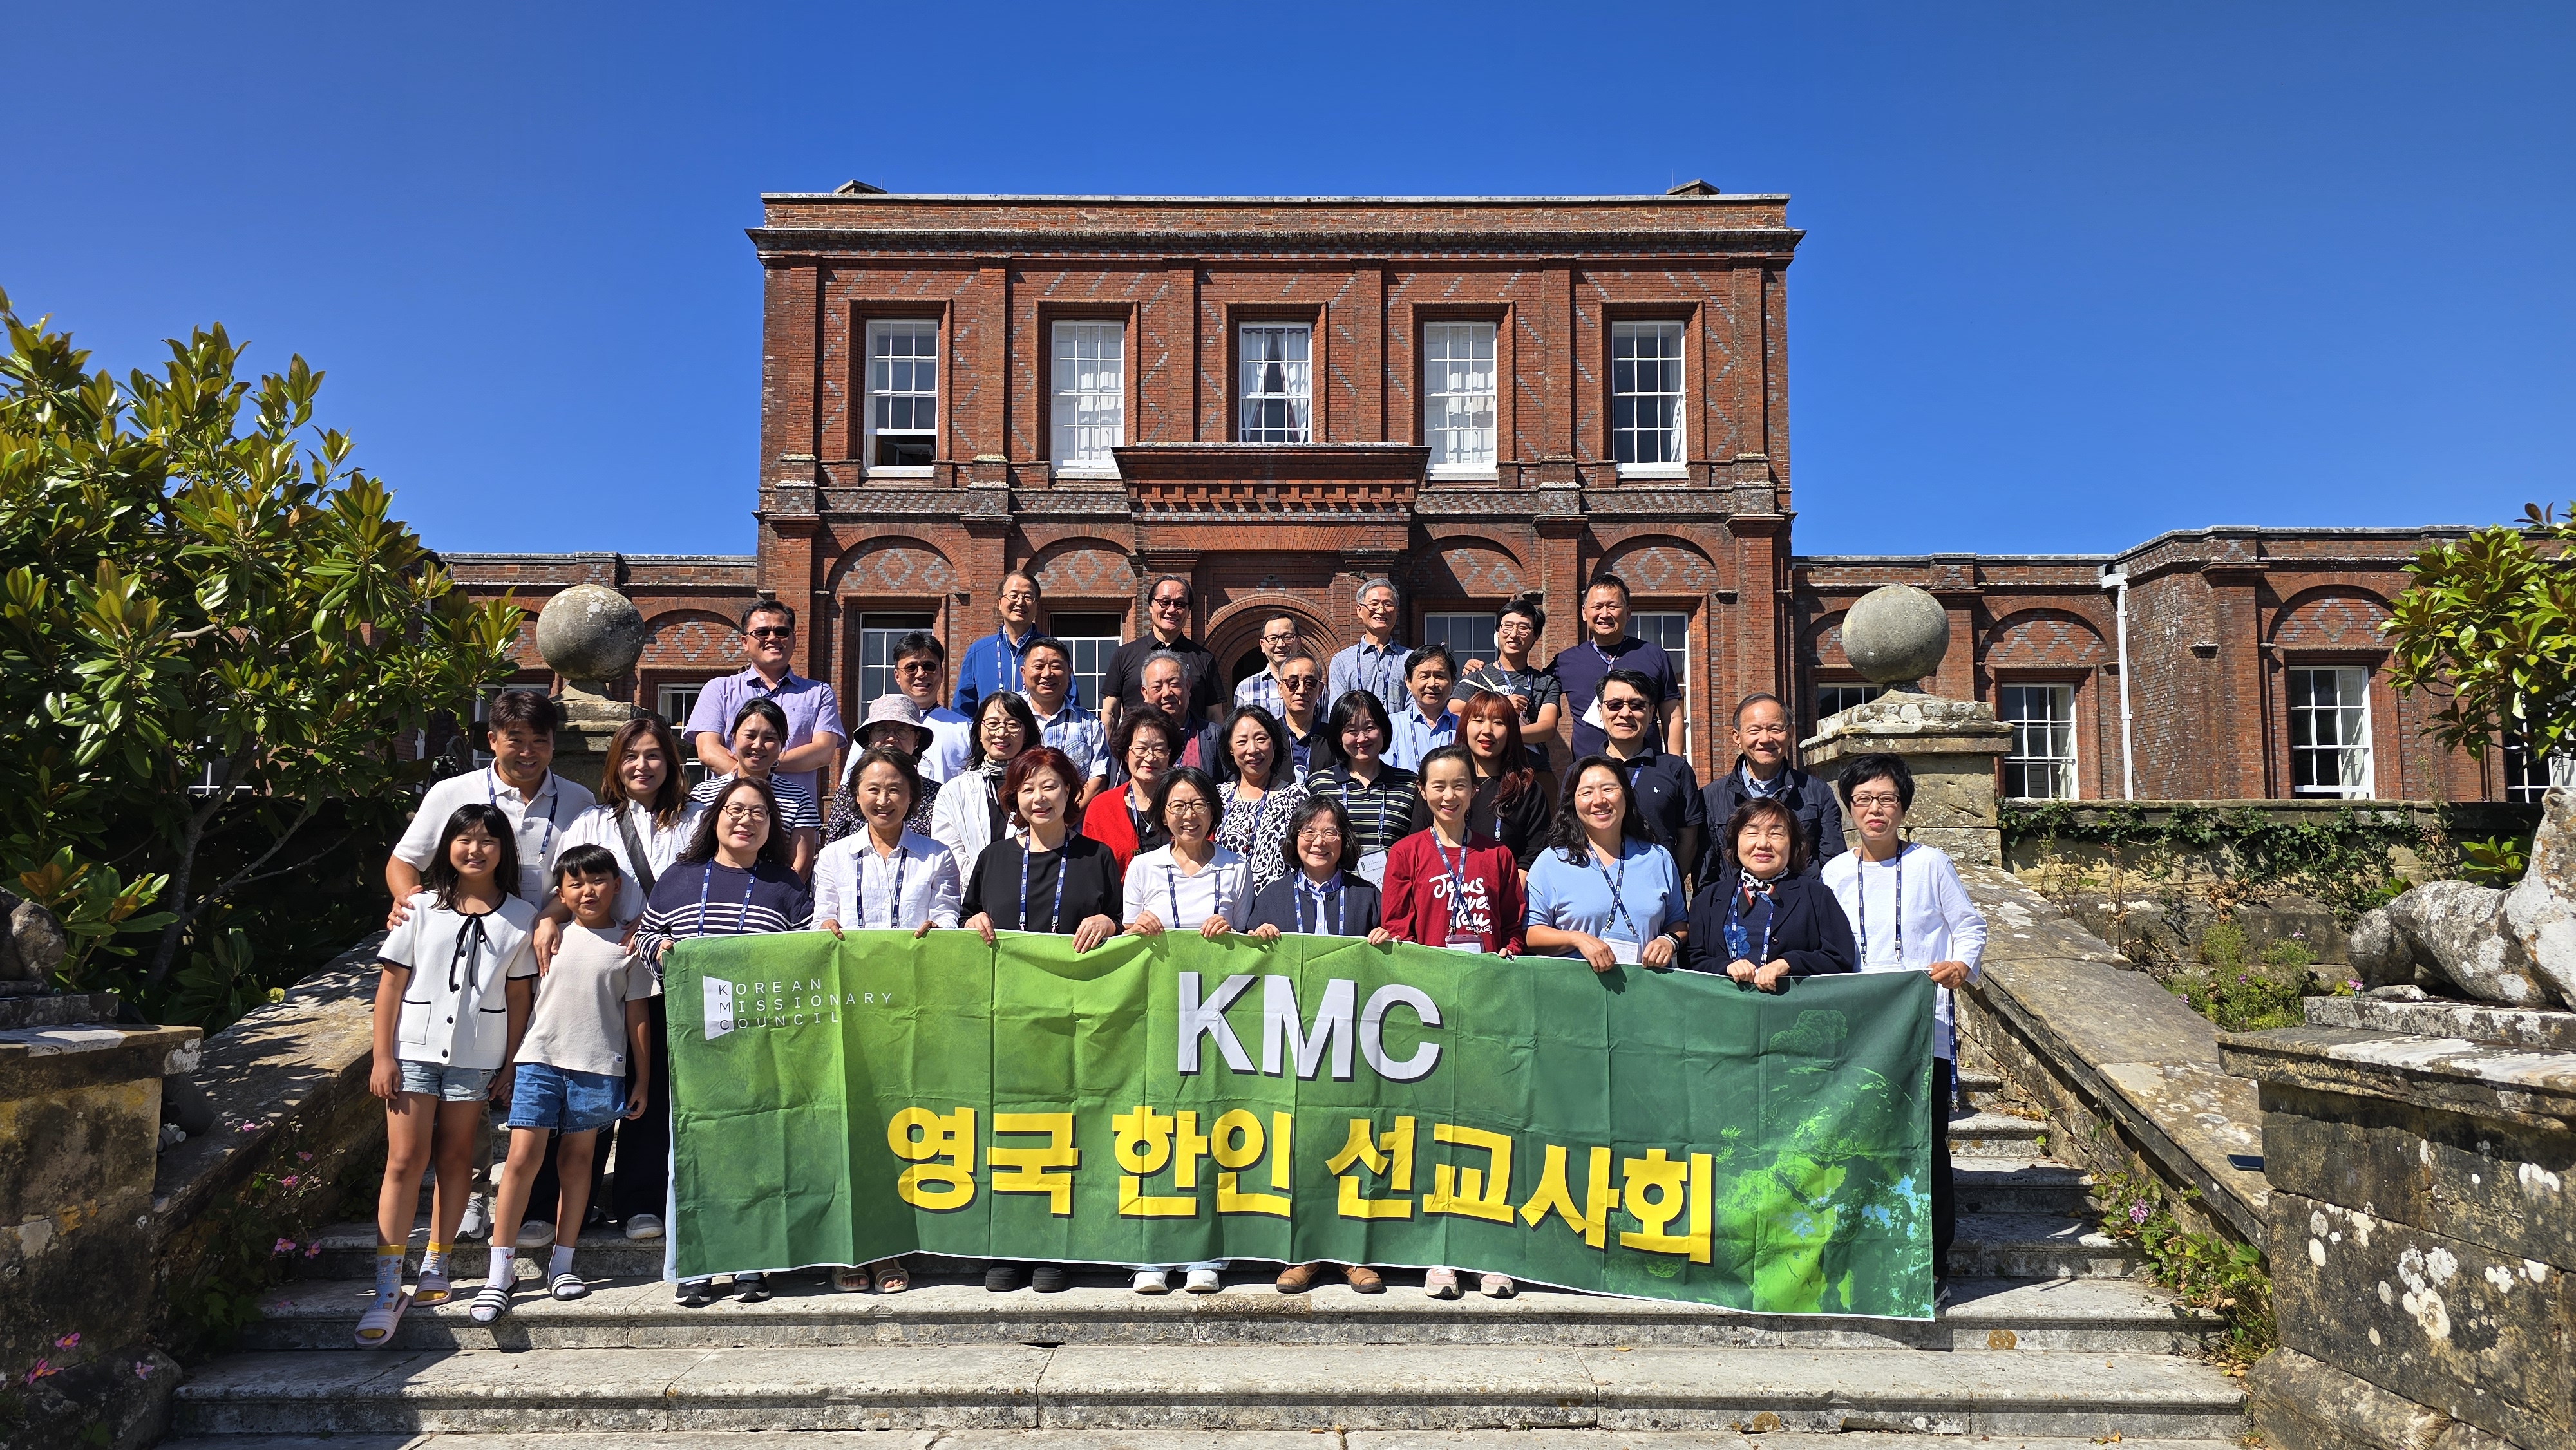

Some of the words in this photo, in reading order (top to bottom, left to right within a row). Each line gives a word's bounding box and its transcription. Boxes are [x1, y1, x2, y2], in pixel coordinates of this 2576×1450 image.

[718, 978, 821, 996] KOREAN
[719, 992, 892, 1013] MISSIONARY
[719, 1011, 839, 1030] COUNCIL
[1177, 971, 1443, 1081] KMC
[887, 1106, 1081, 1216] 영국
[1112, 1106, 1292, 1218] 한인
[1325, 1115, 1713, 1265] 선교사회
